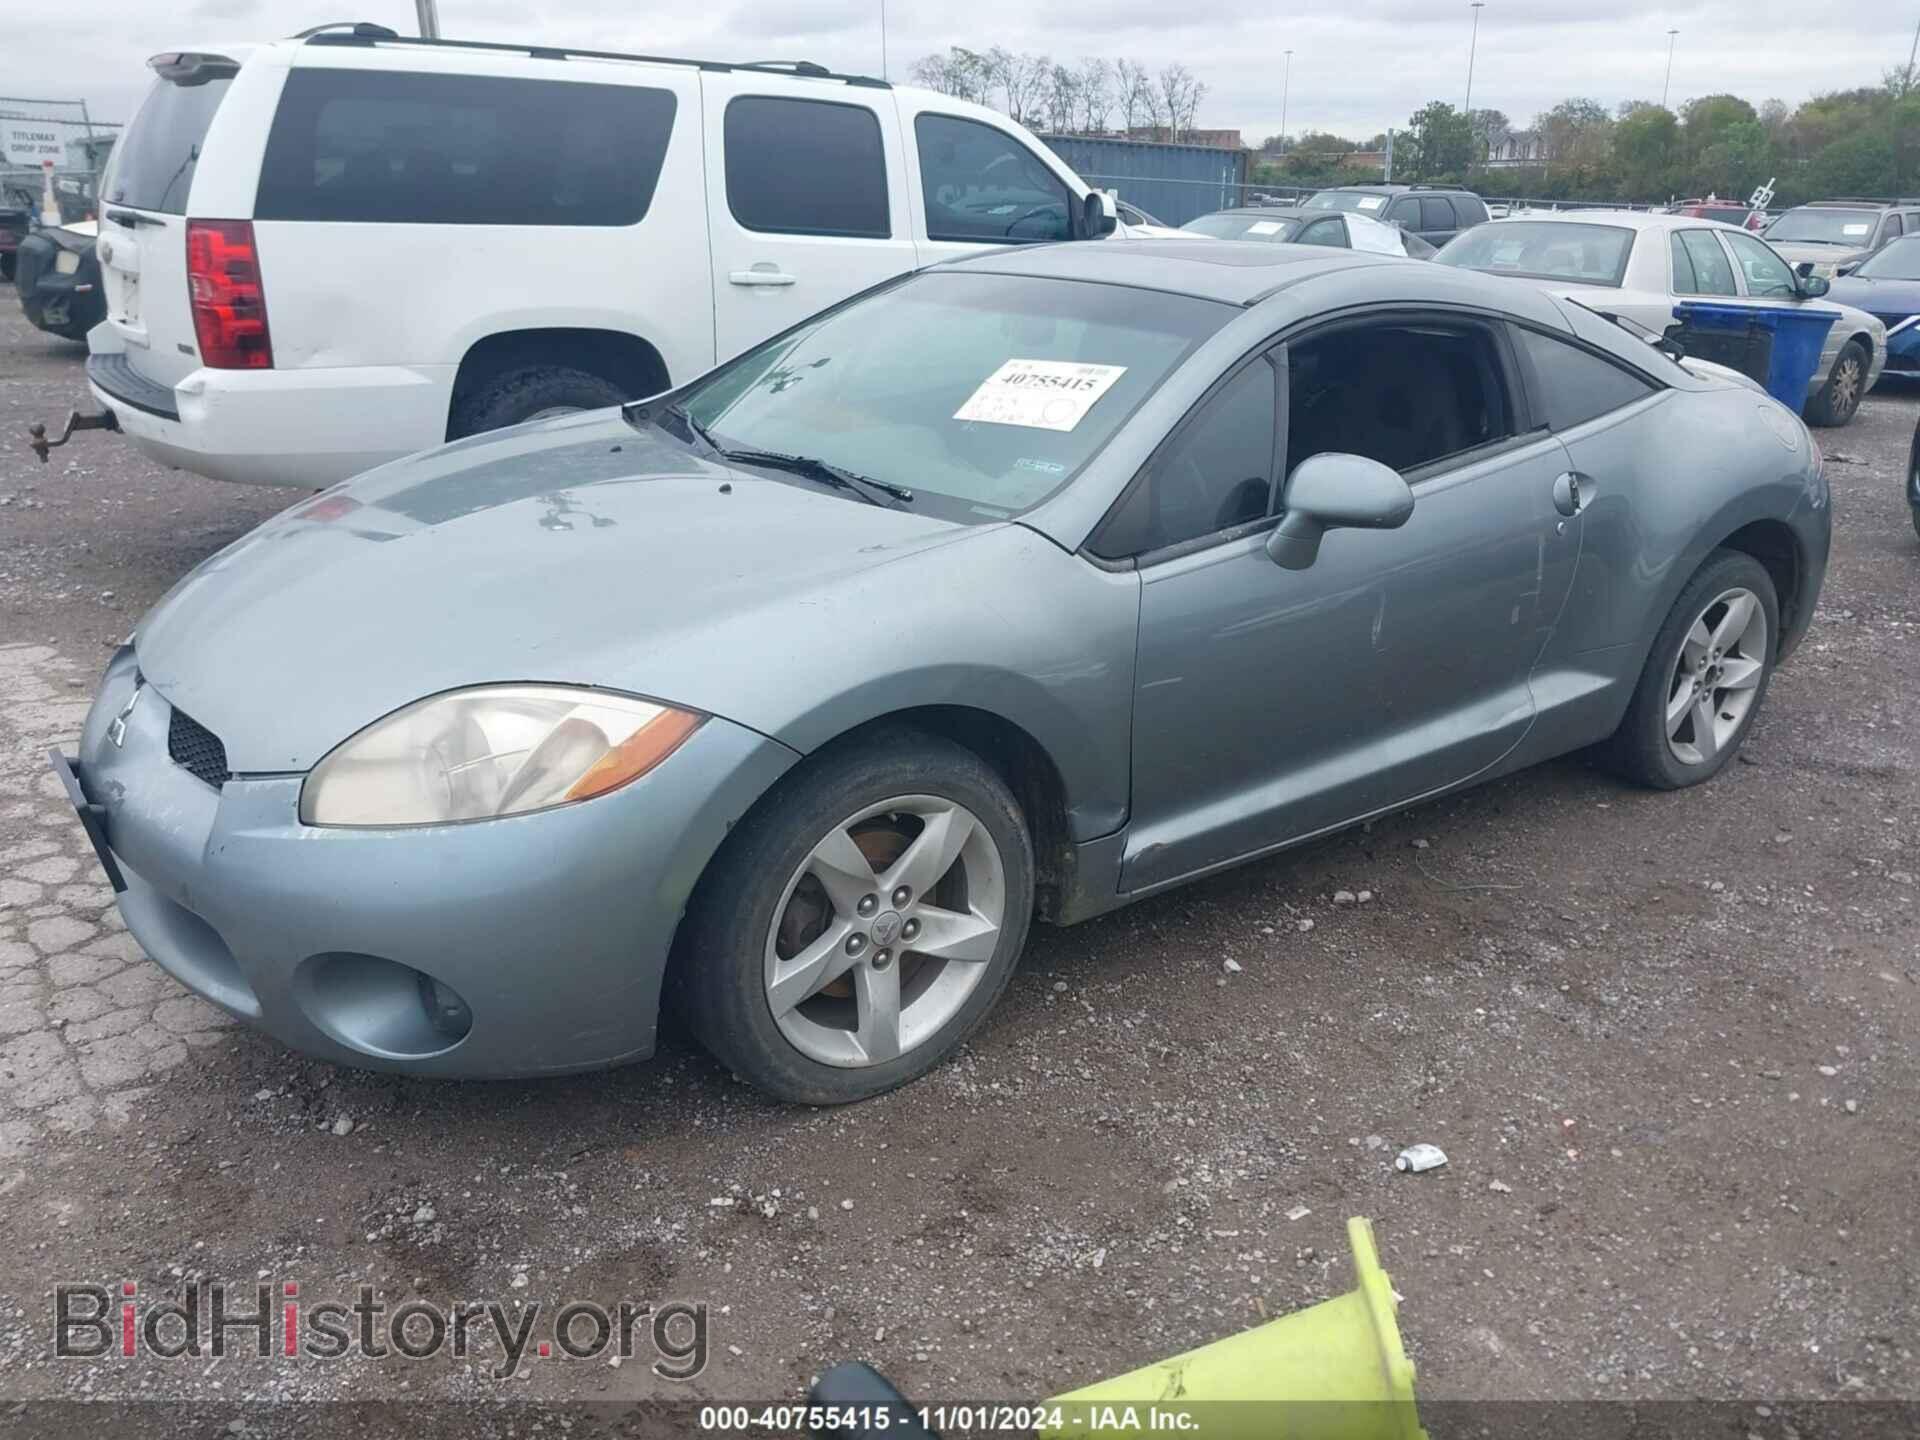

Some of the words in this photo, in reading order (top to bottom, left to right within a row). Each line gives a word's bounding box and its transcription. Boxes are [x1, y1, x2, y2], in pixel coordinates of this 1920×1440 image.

[12, 131, 56, 141] TITLEMAX
[11, 144, 36, 153] DROP
[39, 145, 60, 154] ZONE
[1002, 373, 1097, 392] 40755415
